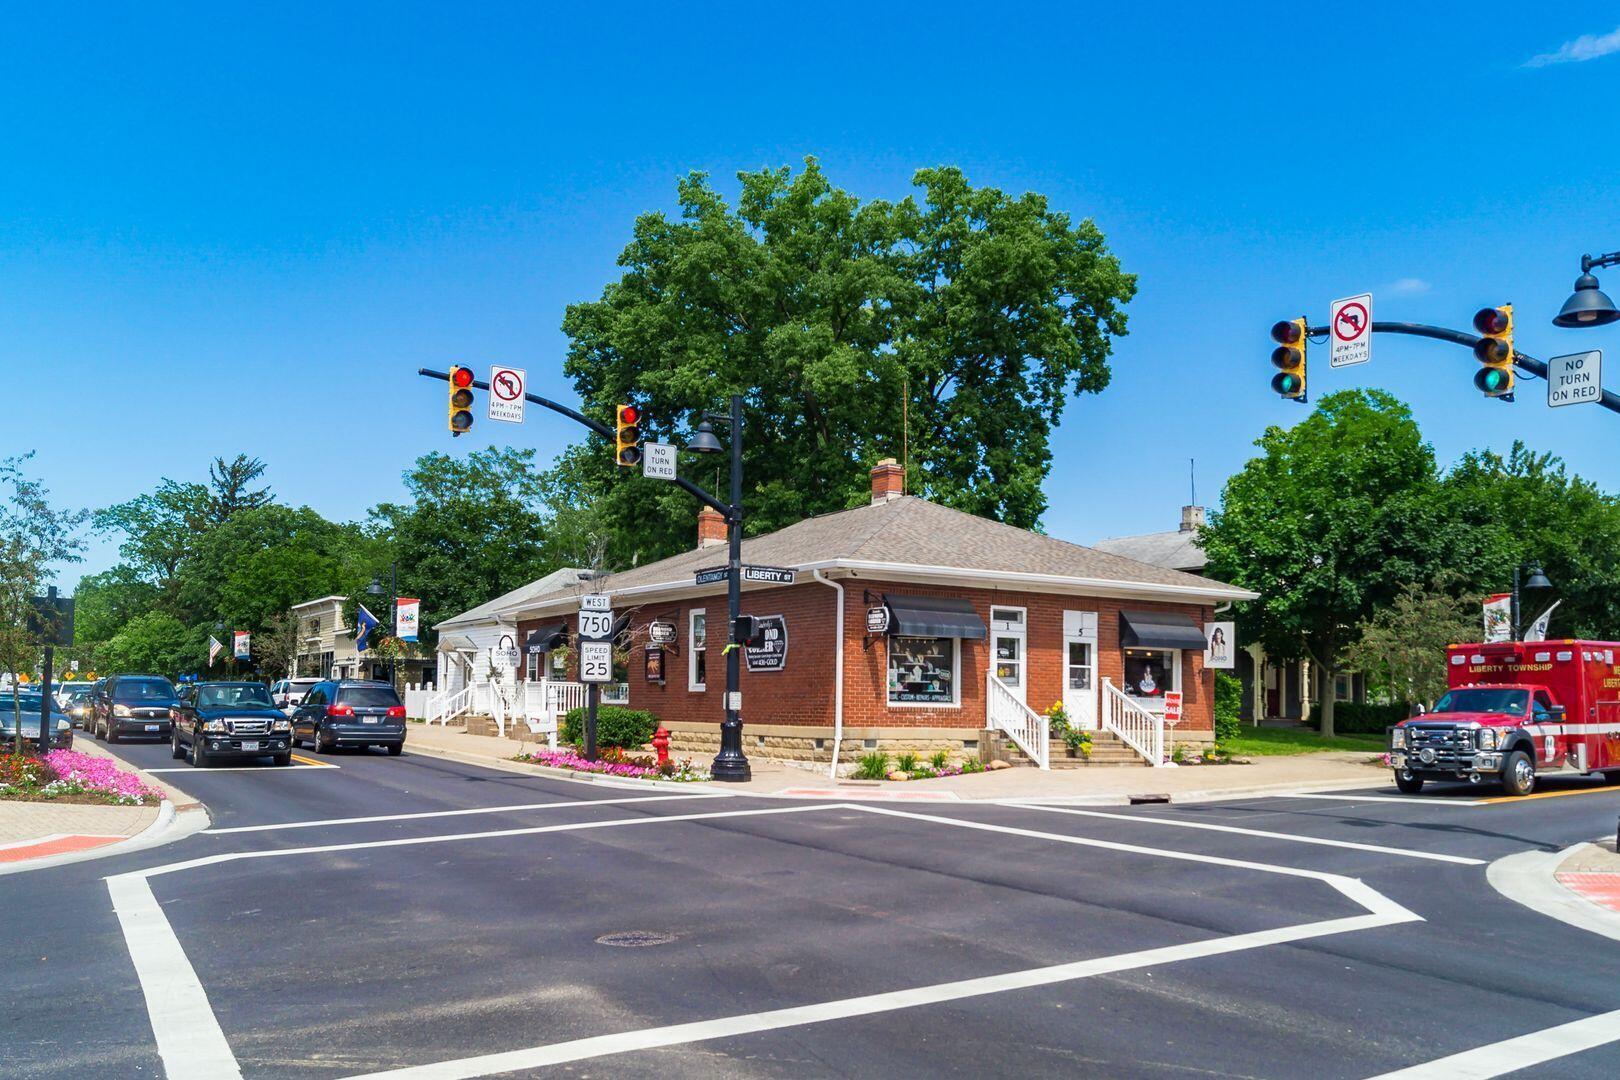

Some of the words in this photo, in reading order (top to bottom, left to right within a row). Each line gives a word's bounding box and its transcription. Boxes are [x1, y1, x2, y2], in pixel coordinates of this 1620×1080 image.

[1334, 351, 1368, 362] WEEKDAYS
[1566, 360, 1584, 370] NO
[1560, 372, 1590, 386] TURN
[1552, 390, 1568, 401] ON
[1573, 386, 1596, 398] RED
[491, 410, 522, 419] WEEKDAYS
[652, 456, 670, 464] TURN
[646, 466, 656, 474] ON
[746, 570, 782, 580] LIBERTY
[586, 598, 606, 606] WEST
[582, 616, 610, 632] 750
[1006, 622, 1010, 630] 1
[1078, 628, 1083, 636] 5
[585, 662, 608, 676] 25
[1508, 664, 1552, 672] TOWNSHIP
